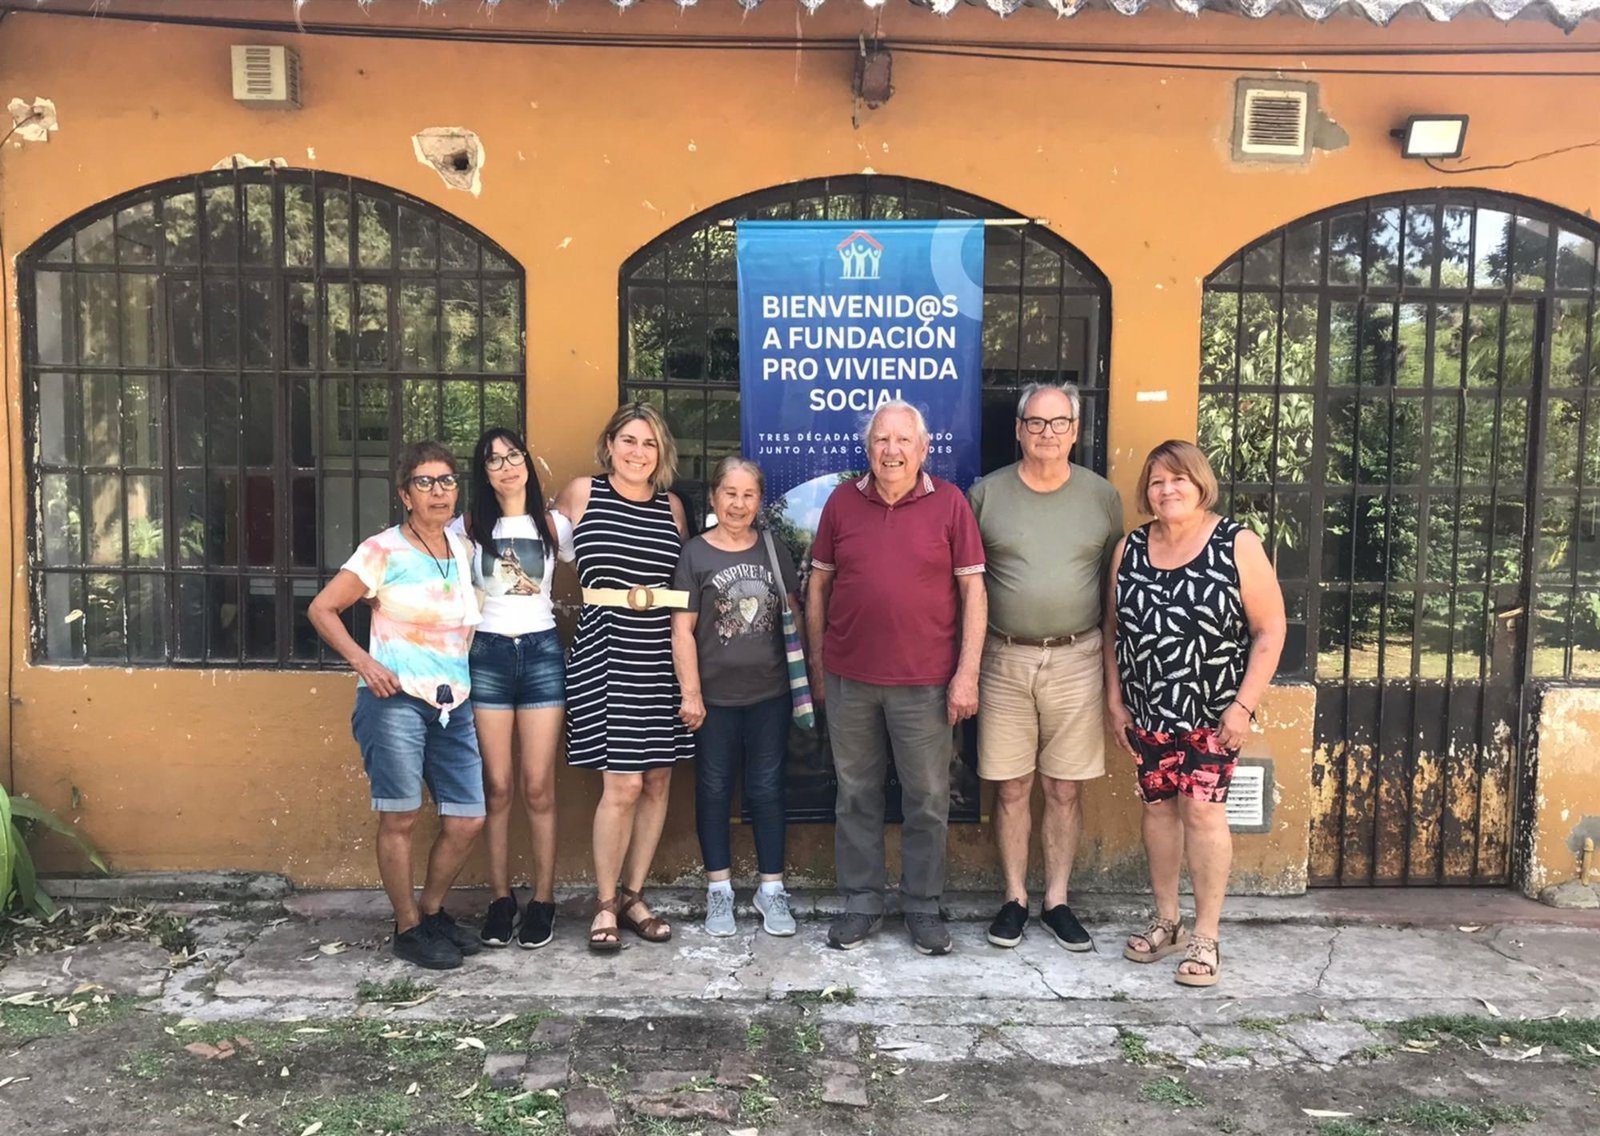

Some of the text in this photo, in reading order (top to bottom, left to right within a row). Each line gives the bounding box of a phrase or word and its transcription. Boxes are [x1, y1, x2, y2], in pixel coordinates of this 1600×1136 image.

[763, 295, 959, 322] BIENVENID@S
[762, 321, 956, 350] A FUNDACIÓN
[763, 357, 959, 381] PRO VIVIENDA
[759, 431, 859, 441] TRES DÉCADAS
[759, 446, 800, 454] JUNTO
[808, 446, 815, 454] A
[823, 446, 847, 454] LAS
[712, 563, 759, 589] INSPIRE
